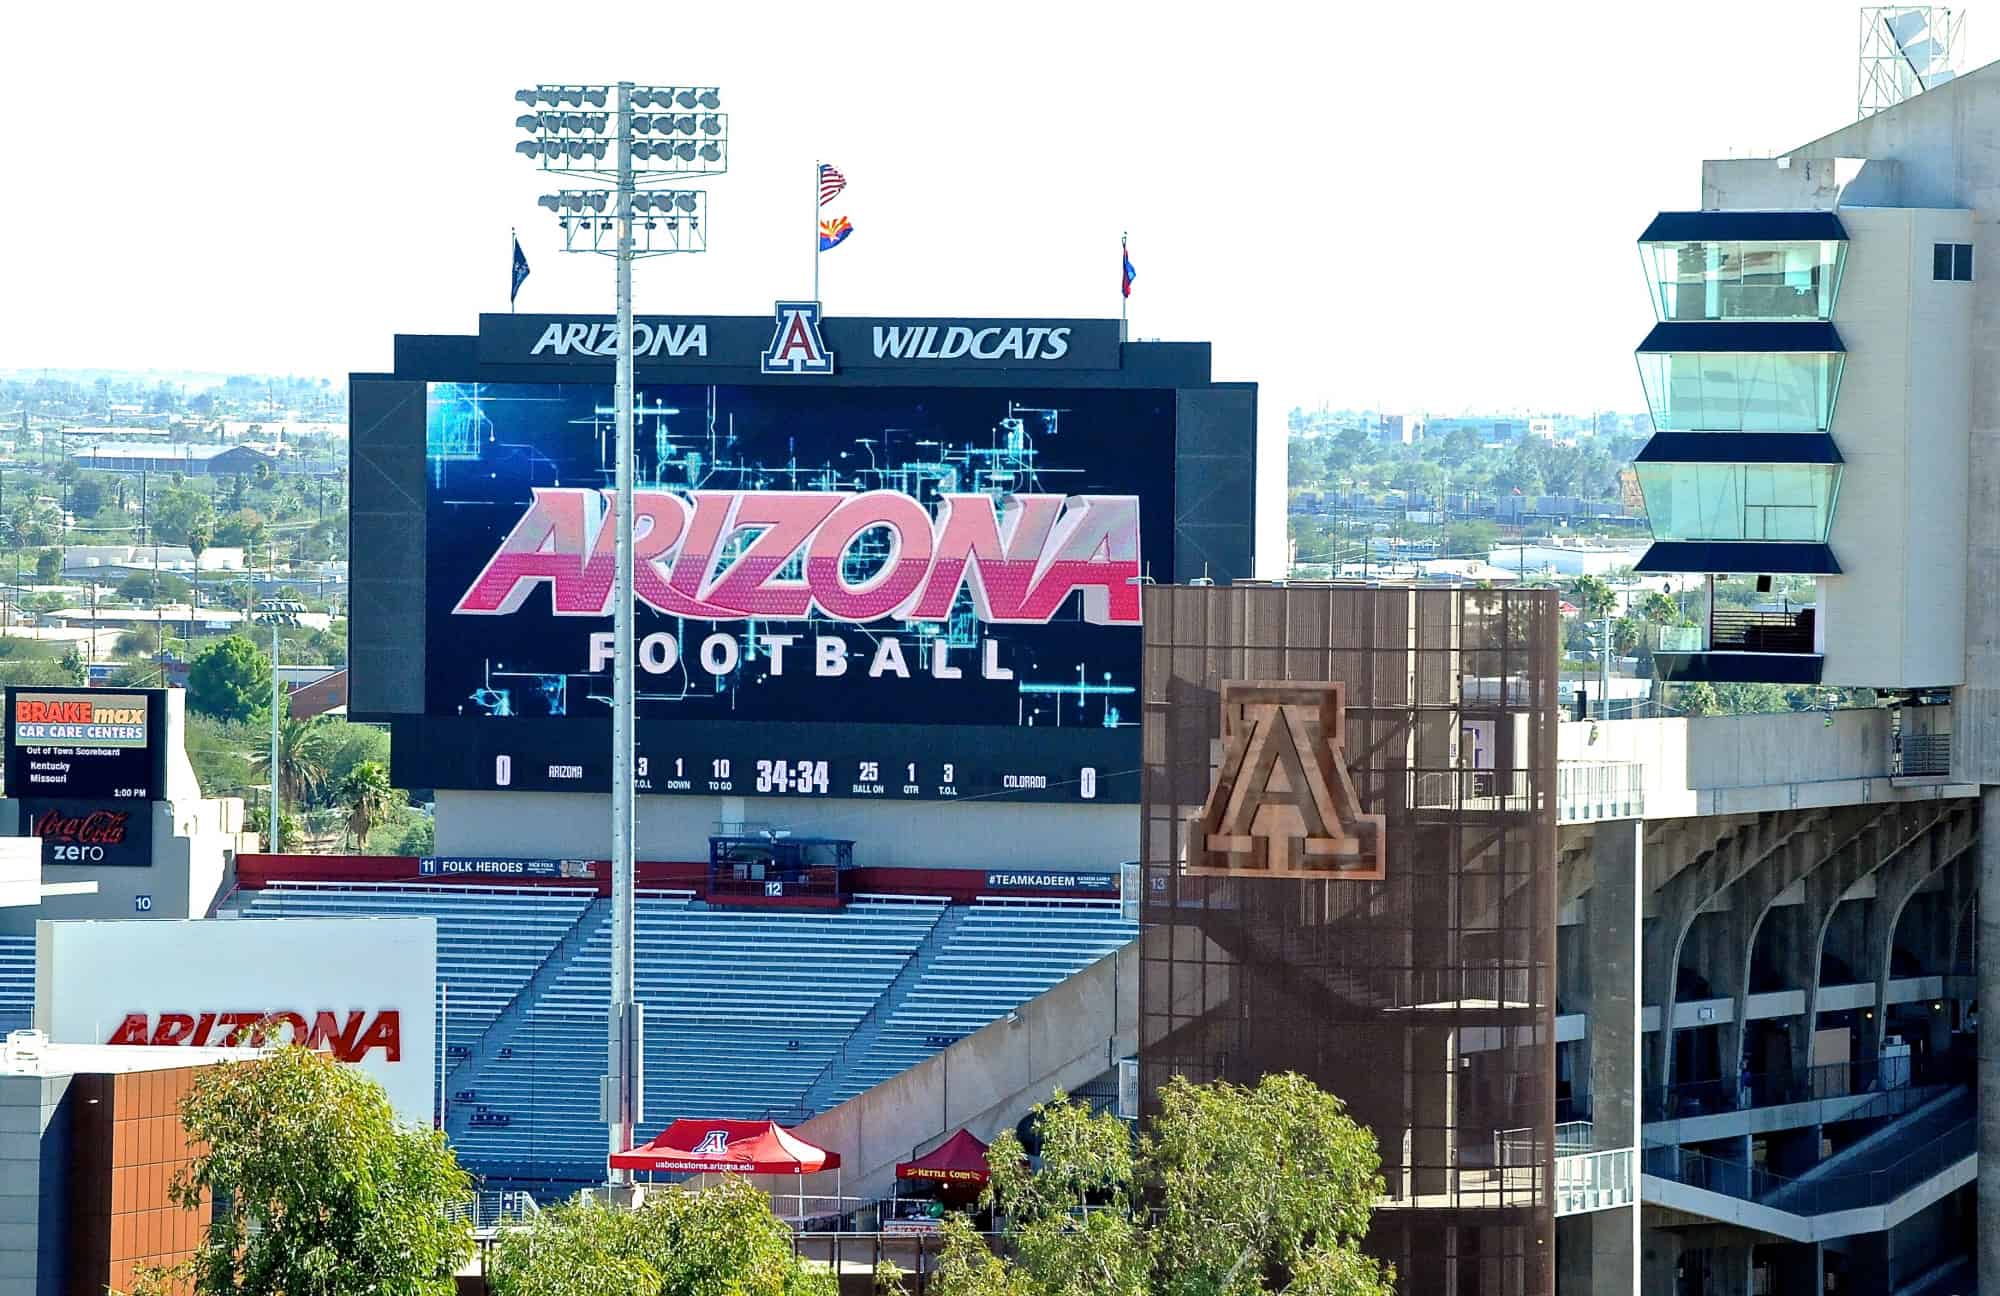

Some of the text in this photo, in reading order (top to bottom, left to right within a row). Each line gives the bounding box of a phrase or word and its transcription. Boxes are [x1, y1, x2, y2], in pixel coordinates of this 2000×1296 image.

[530, 323, 708, 357] ARIZONA
[760, 301, 834, 374] A
[872, 326, 1071, 360] WILDCATS
[450, 487, 1142, 626] ARIZONA
[589, 631, 1014, 680] FOOTBALL
[19, 726, 143, 739] CAR CARE CENTERS
[26, 747, 120, 757] Out of Town Scoreboard
[30, 761, 71, 773] Kentucky
[496, 755, 511, 786] 0
[549, 765, 582, 779] ARIZONA
[638, 757, 648, 776] 3
[675, 758, 683, 777] 1
[712, 759, 730, 778] 10
[859, 762, 879, 781] 25
[907, 763, 915, 782] 1
[943, 764, 954, 782] 3
[30, 774, 67, 783] Missouri
[756, 760, 829, 793] 34:34
[1003, 775, 1046, 789] COLORADO
[1081, 767, 1096, 798] 0
[1181, 680, 1386, 881] A
[114, 788, 146, 797] 1:00 PM
[667, 780, 691, 790] DOWN
[708, 781, 732, 791] TO GO
[853, 785, 884, 794] BALL ON
[904, 785, 919, 794] QTR
[54, 846, 104, 861] zero
[422, 861, 434, 873] 11
[443, 861, 472, 873] FOLK
[476, 862, 523, 873] HEROES
[989, 874, 1075, 887] #TEAMKADEEM
[766, 883, 782, 897] 12
[136, 897, 151, 910] 10
[691, 1130, 728, 1154] A
